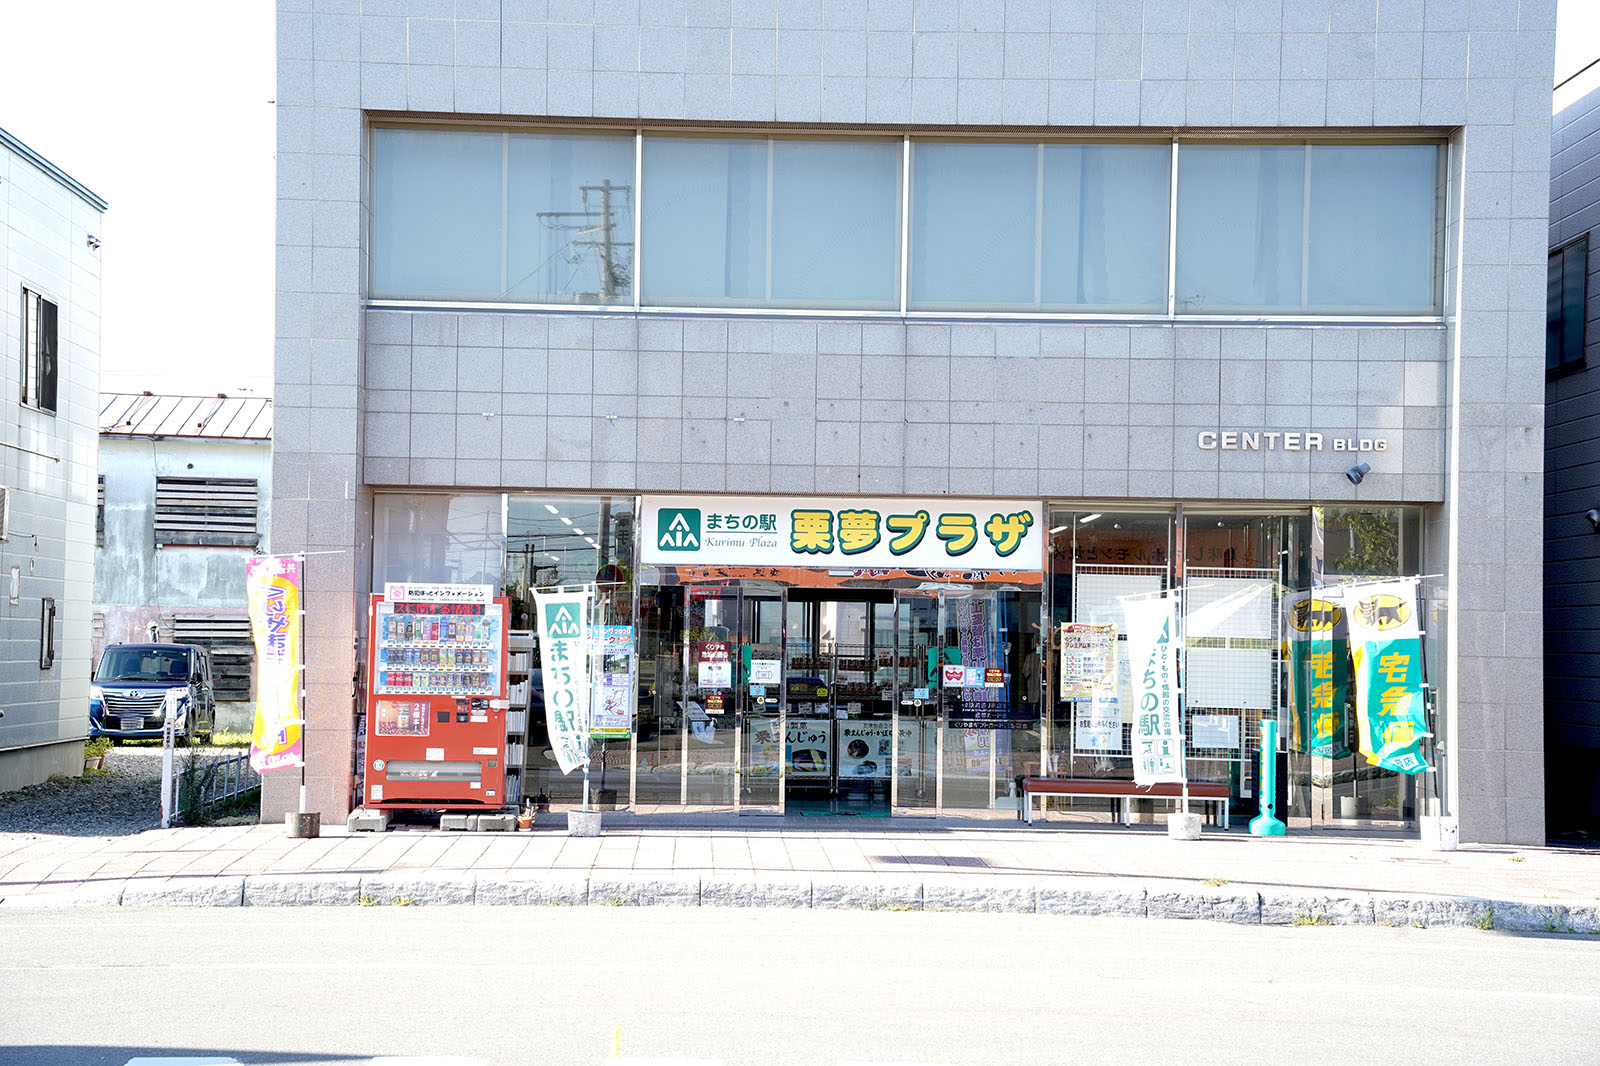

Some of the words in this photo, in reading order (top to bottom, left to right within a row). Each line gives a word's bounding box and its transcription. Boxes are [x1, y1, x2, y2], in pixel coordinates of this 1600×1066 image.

[1198, 431, 1323, 451] CENTER
[1333, 438, 1388, 451] BLDG
[706, 513, 777, 531] まちの駅
[704, 537, 746, 548] Kurimu
[748, 536, 778, 549] Plaza
[790, 509, 1034, 558] 栗夢プラザ
[1138, 648, 1161, 736] ちの駅
